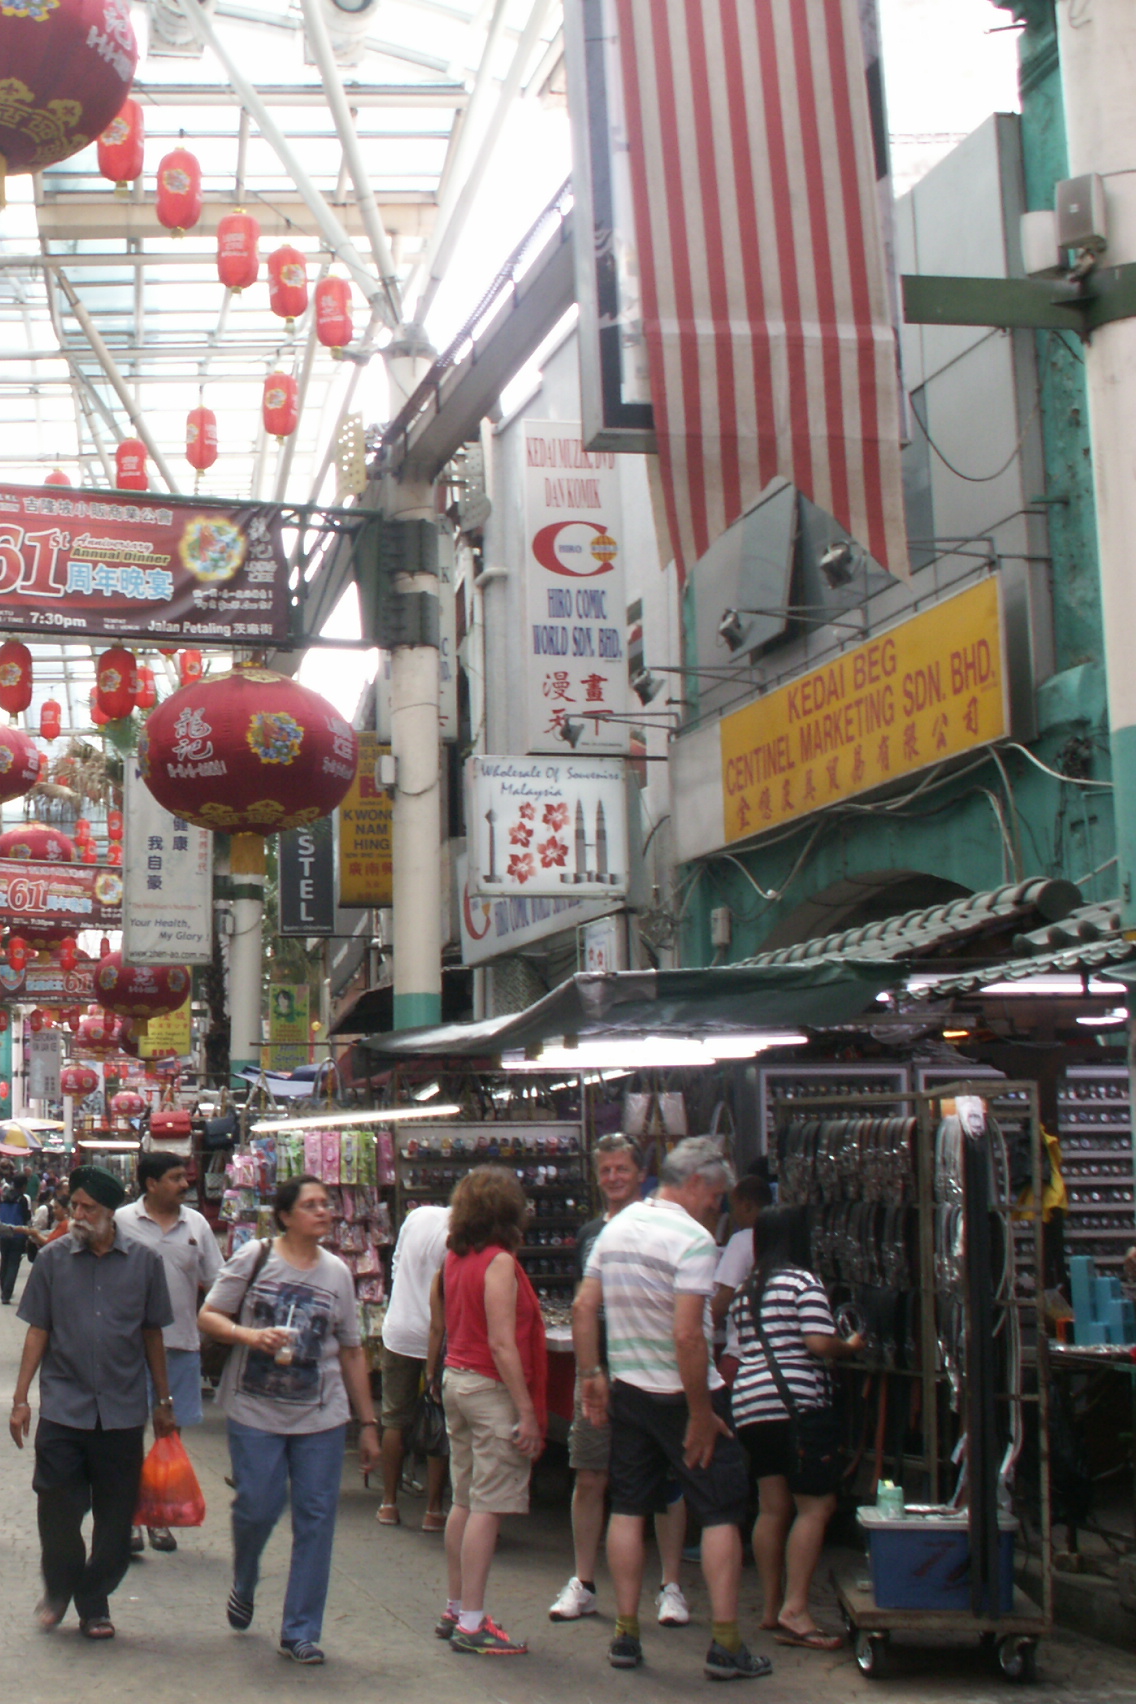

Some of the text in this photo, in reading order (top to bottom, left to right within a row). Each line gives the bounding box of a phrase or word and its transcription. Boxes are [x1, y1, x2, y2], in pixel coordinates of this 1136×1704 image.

[526, 438, 557, 469] KEDAI
[545, 477, 601, 509] DAN KOMIK
[70, 546, 171, 566] Annual Dinner
[559, 545, 582, 553] HIRO
[66, 561, 173, 601] 周年晚宴
[547, 588, 607, 620] HIRO COMIC
[29, 611, 87, 628] 7:30pm
[148, 620, 180, 634] Jalan
[183, 621, 232, 637] Petaling
[533, 625, 568, 657] WORLD
[787, 638, 897, 724] KEDAI BEG
[725, 638, 996, 797] CENTINEL MARKETING SDN. BHD.
[481, 765, 542, 778] Wholesale
[545, 766, 560, 783] Of
[500, 782, 563, 800] Malaysia
[356, 824, 387, 835] NAM
[354, 838, 390, 850] HING
[147, 836, 163, 891] 我自豪
[130, 918, 191, 929] Your Health,
[159, 931, 172, 941] My
[176, 931, 203, 942] Glory
[129, 951, 210, 960] www.zhen-ao.com.my
